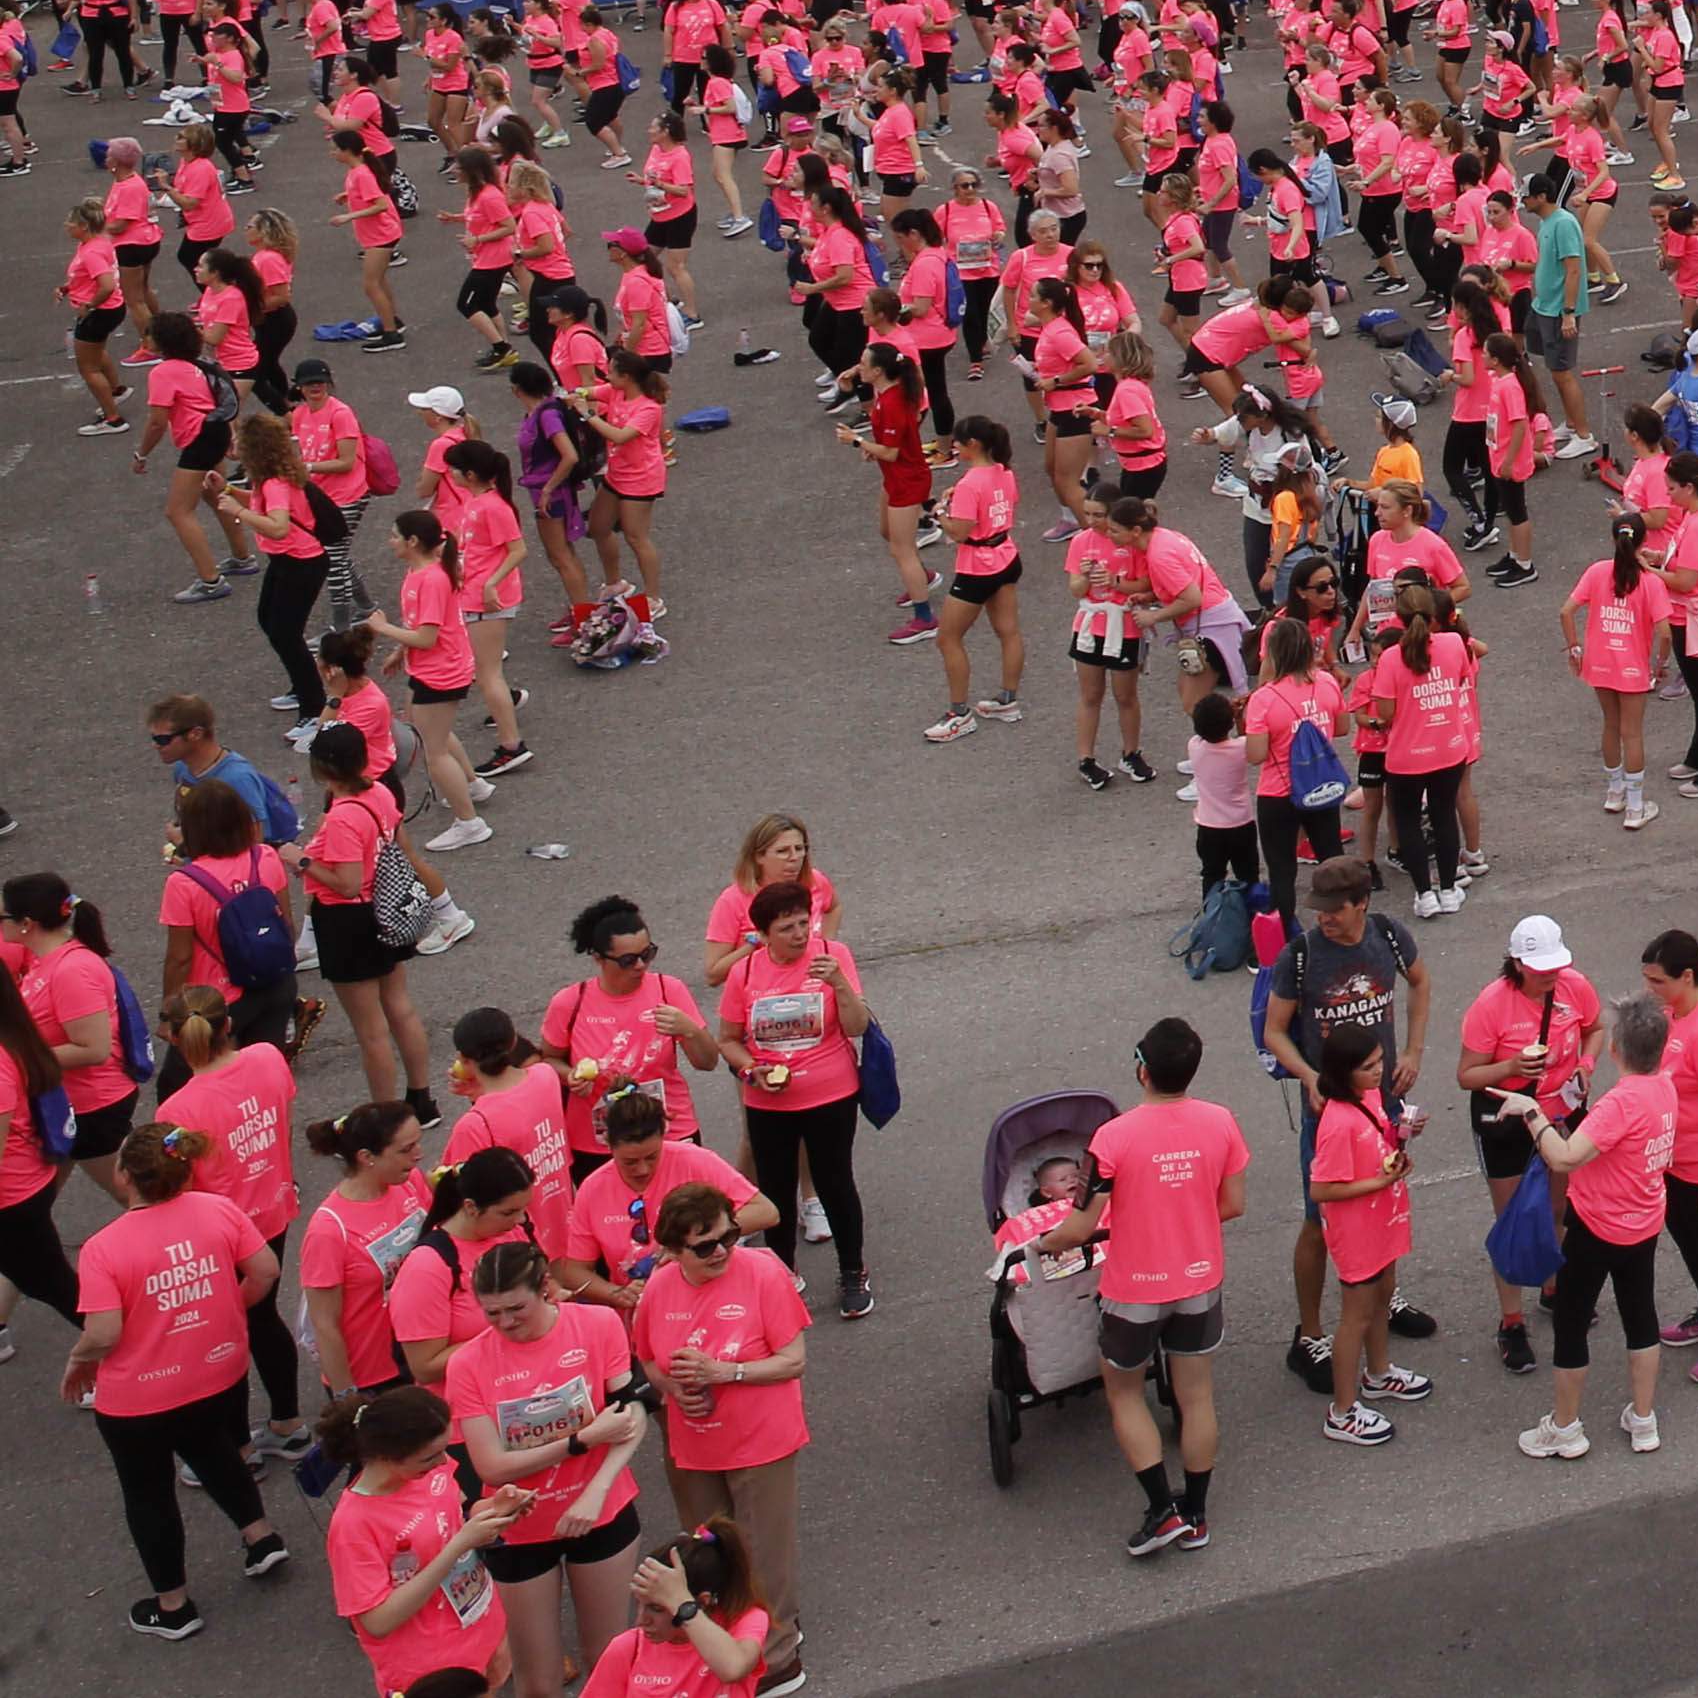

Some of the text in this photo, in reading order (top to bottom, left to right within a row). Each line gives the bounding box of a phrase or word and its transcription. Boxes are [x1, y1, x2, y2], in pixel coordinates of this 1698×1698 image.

[1602, 621, 1632, 635] SUMA
[1412, 678, 1456, 699] DORSAL
[1302, 699, 1317, 714] TU
[1419, 693, 1453, 711] SUMA
[237, 1096, 259, 1120] TU
[534, 1117, 551, 1143] TU
[1661, 1112, 1674, 1131] TU
[236, 1127, 277, 1164] SUMA
[1151, 1150, 1201, 1164] CARRERA
[1159, 1170, 1195, 1183] MUJER
[1161, 1161, 1193, 1173] DE LA
[165, 1239, 194, 1266] TU
[146, 1253, 219, 1296] DORSAL
[157, 1278, 214, 1313] SUMA
[173, 1309, 201, 1327] 2024
[137, 1363, 182, 1383] OYSHO
[495, 1370, 531, 1388] OYSHO
